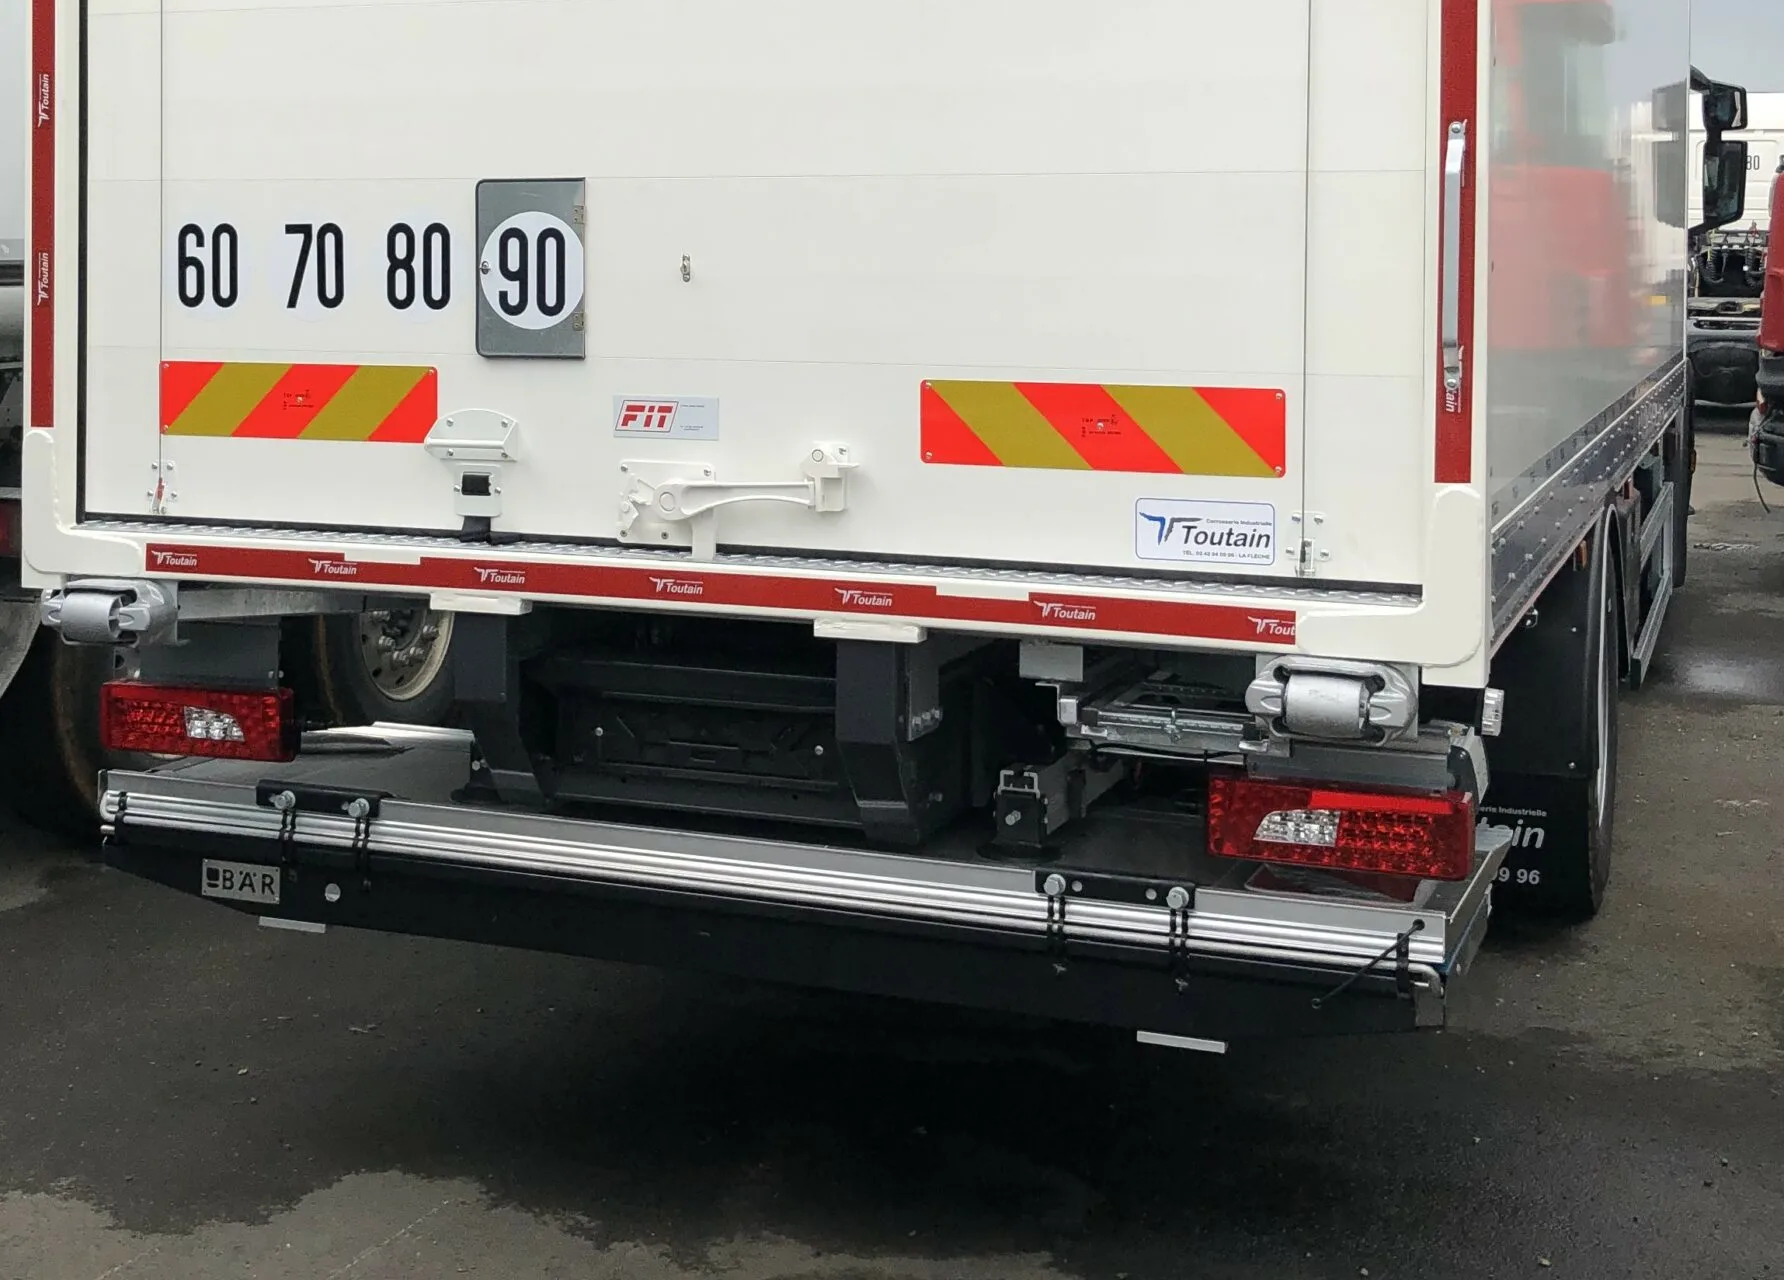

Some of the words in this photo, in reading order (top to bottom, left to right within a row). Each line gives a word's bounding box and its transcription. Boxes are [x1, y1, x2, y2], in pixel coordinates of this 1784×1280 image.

[41, 73, 49, 110] Toutain
[177, 222, 238, 308] 60
[284, 222, 344, 309] 70
[386, 222, 451, 310] 80
[498, 226, 566, 317] 90
[621, 405, 673, 428] FIT
[1182, 526, 1270, 548] Toutain
[165, 555, 197, 566] Toutain
[324, 564, 356, 575] Toutain
[490, 573, 525, 584] Toutain
[666, 582, 702, 594] Toutain
[853, 594, 892, 606] Toutain
[1053, 608, 1095, 620] Toutain
[221, 869, 276, 896] BÄR
[1516, 869, 1541, 885] 96
